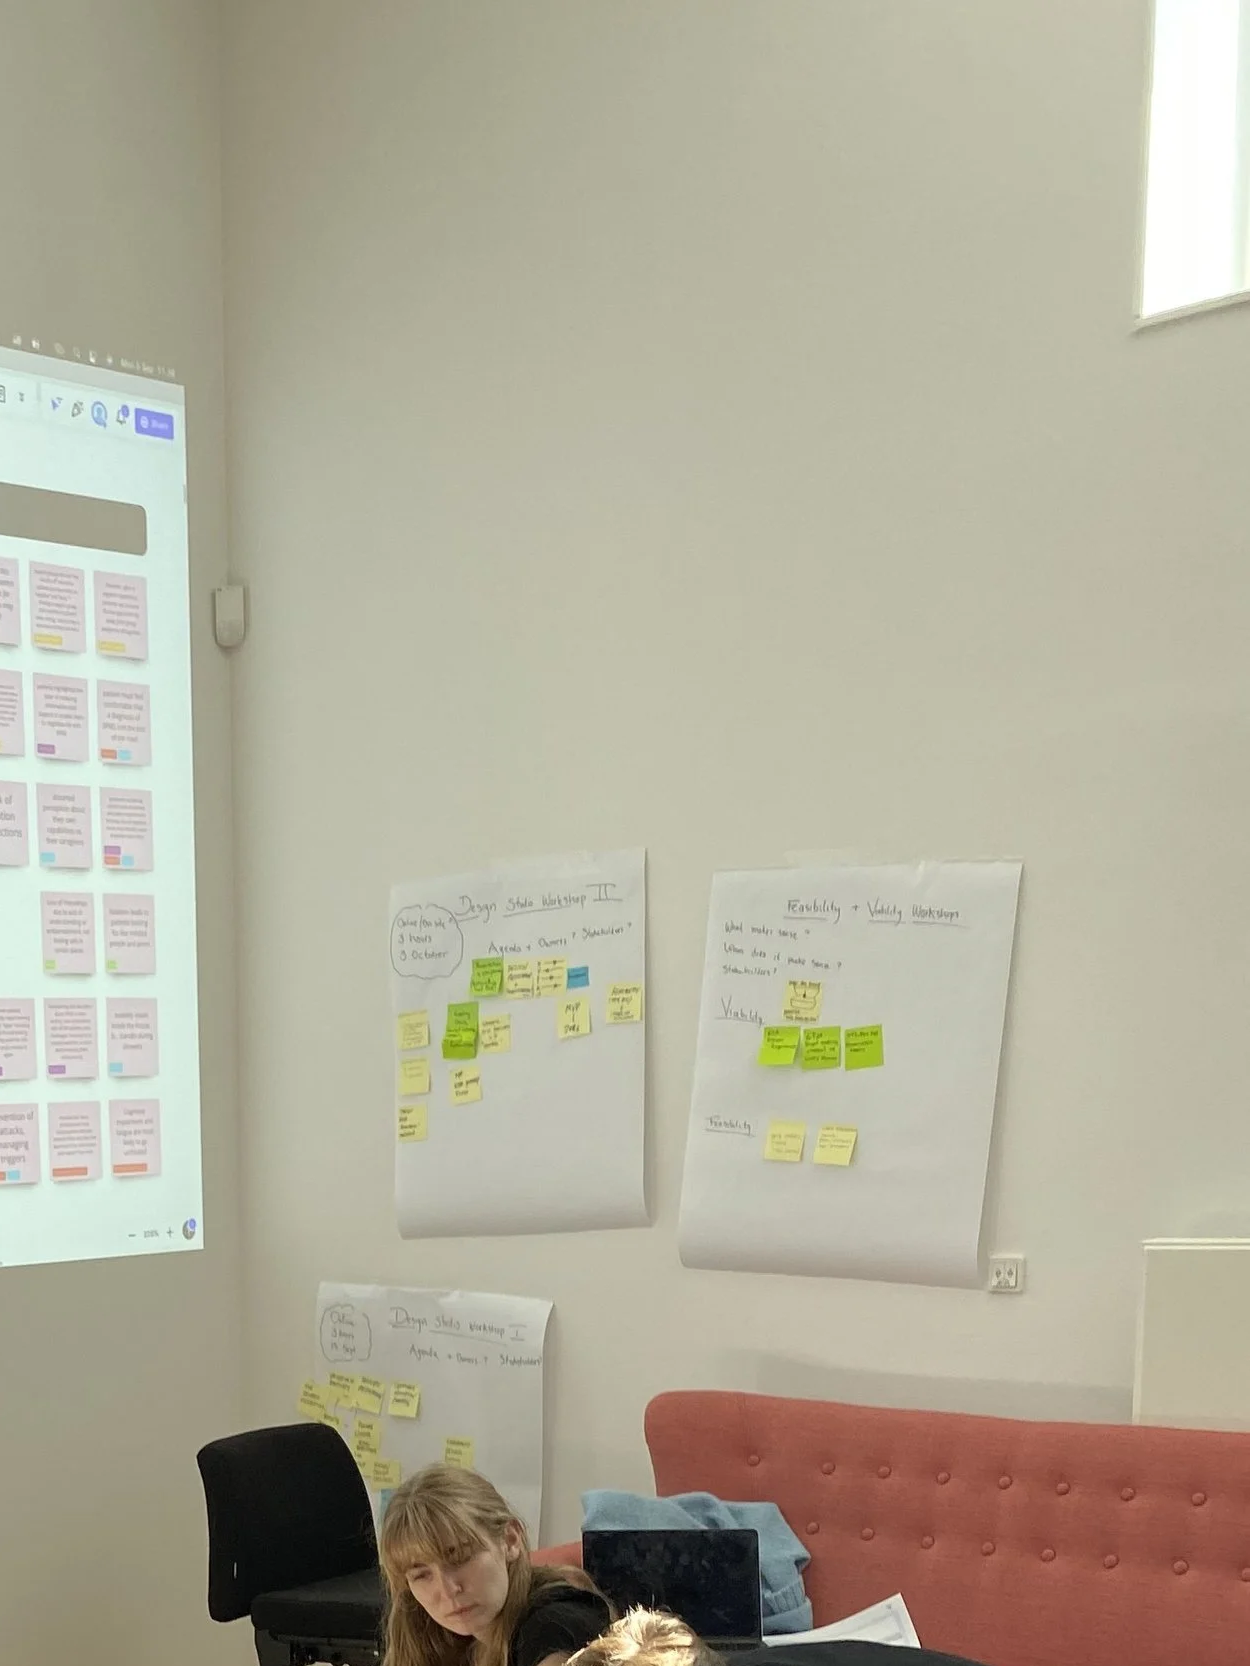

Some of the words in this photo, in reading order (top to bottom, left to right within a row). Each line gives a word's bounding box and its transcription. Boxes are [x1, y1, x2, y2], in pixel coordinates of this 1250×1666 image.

[4, 794, 12, 804] of
[454, 896, 497, 923] Design
[505, 897, 533, 911] Studio
[542, 894, 586, 914] Workshop
[787, 899, 841, 924] Feasibility
[867, 897, 903, 927] Viability
[412, 950, 449, 959] October
[488, 942, 522, 958] Agenda
[720, 995, 764, 1026] Viability
[705, 1115, 750, 1134] Feasibility
[388, 1306, 428, 1334] Design
[435, 1315, 460, 1330] Studio
[409, 1344, 440, 1361] Agenda
